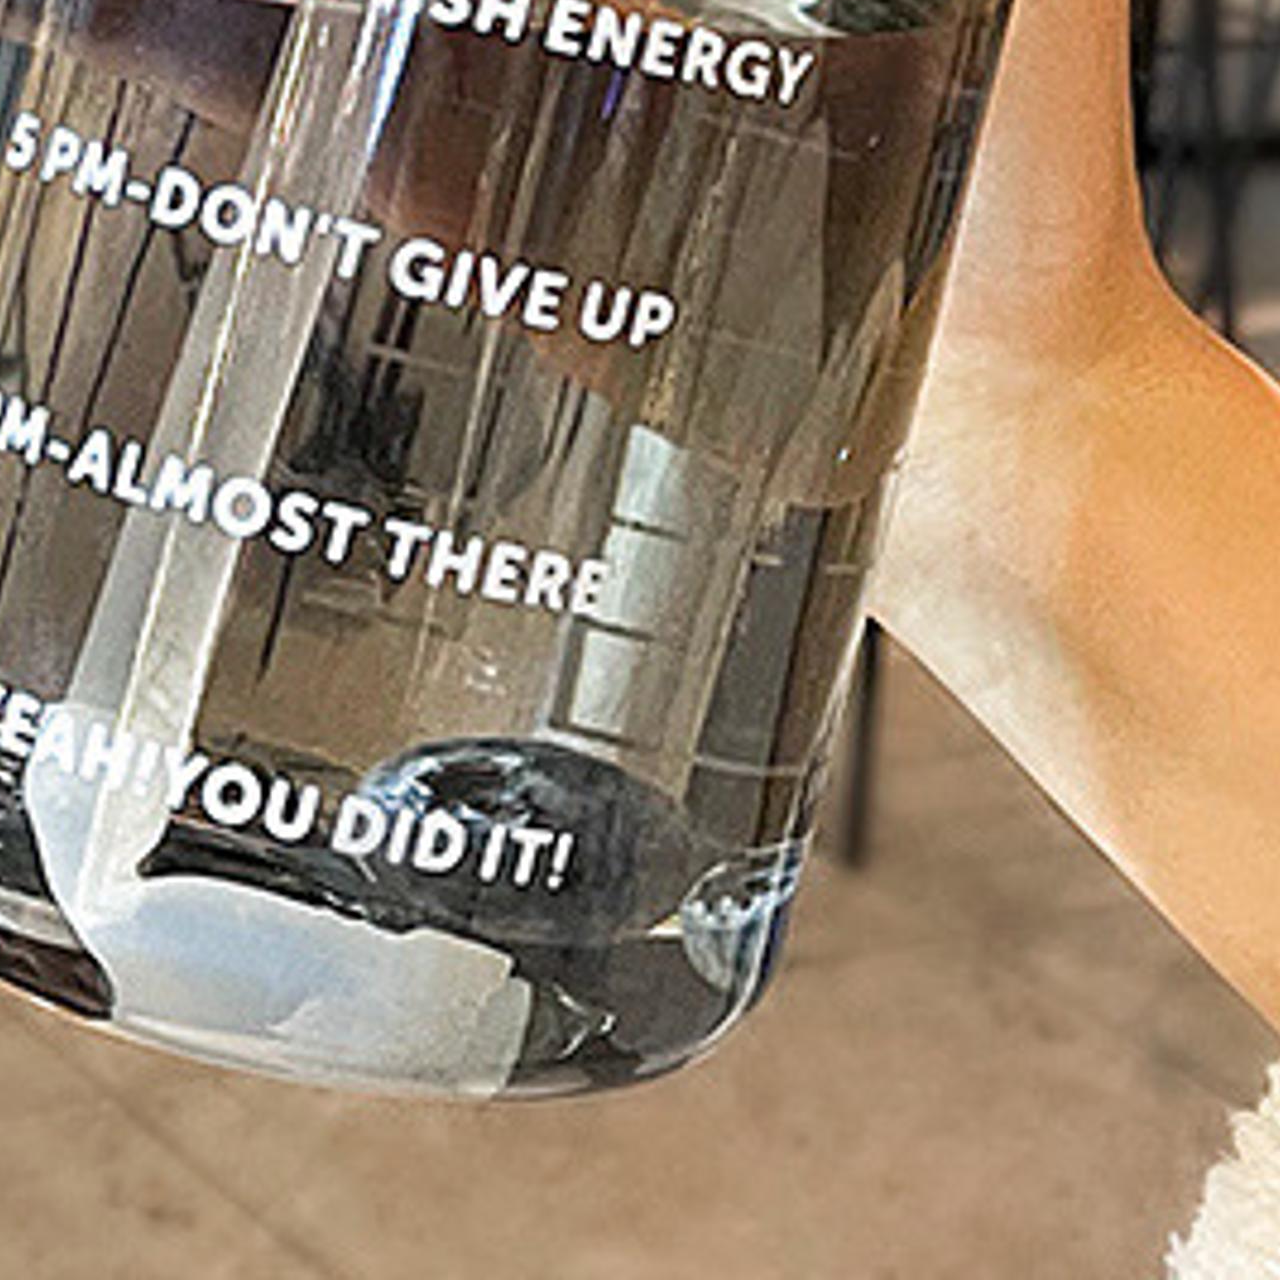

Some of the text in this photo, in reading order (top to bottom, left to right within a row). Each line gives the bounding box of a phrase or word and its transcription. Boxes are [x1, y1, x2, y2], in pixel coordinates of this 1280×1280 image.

[389, 238, 569, 331] GIVE
[580, 281, 675, 347] UP
[384, 518, 611, 617] THERE
[331, 793, 467, 872] DID
[479, 822, 573, 889] IT!
